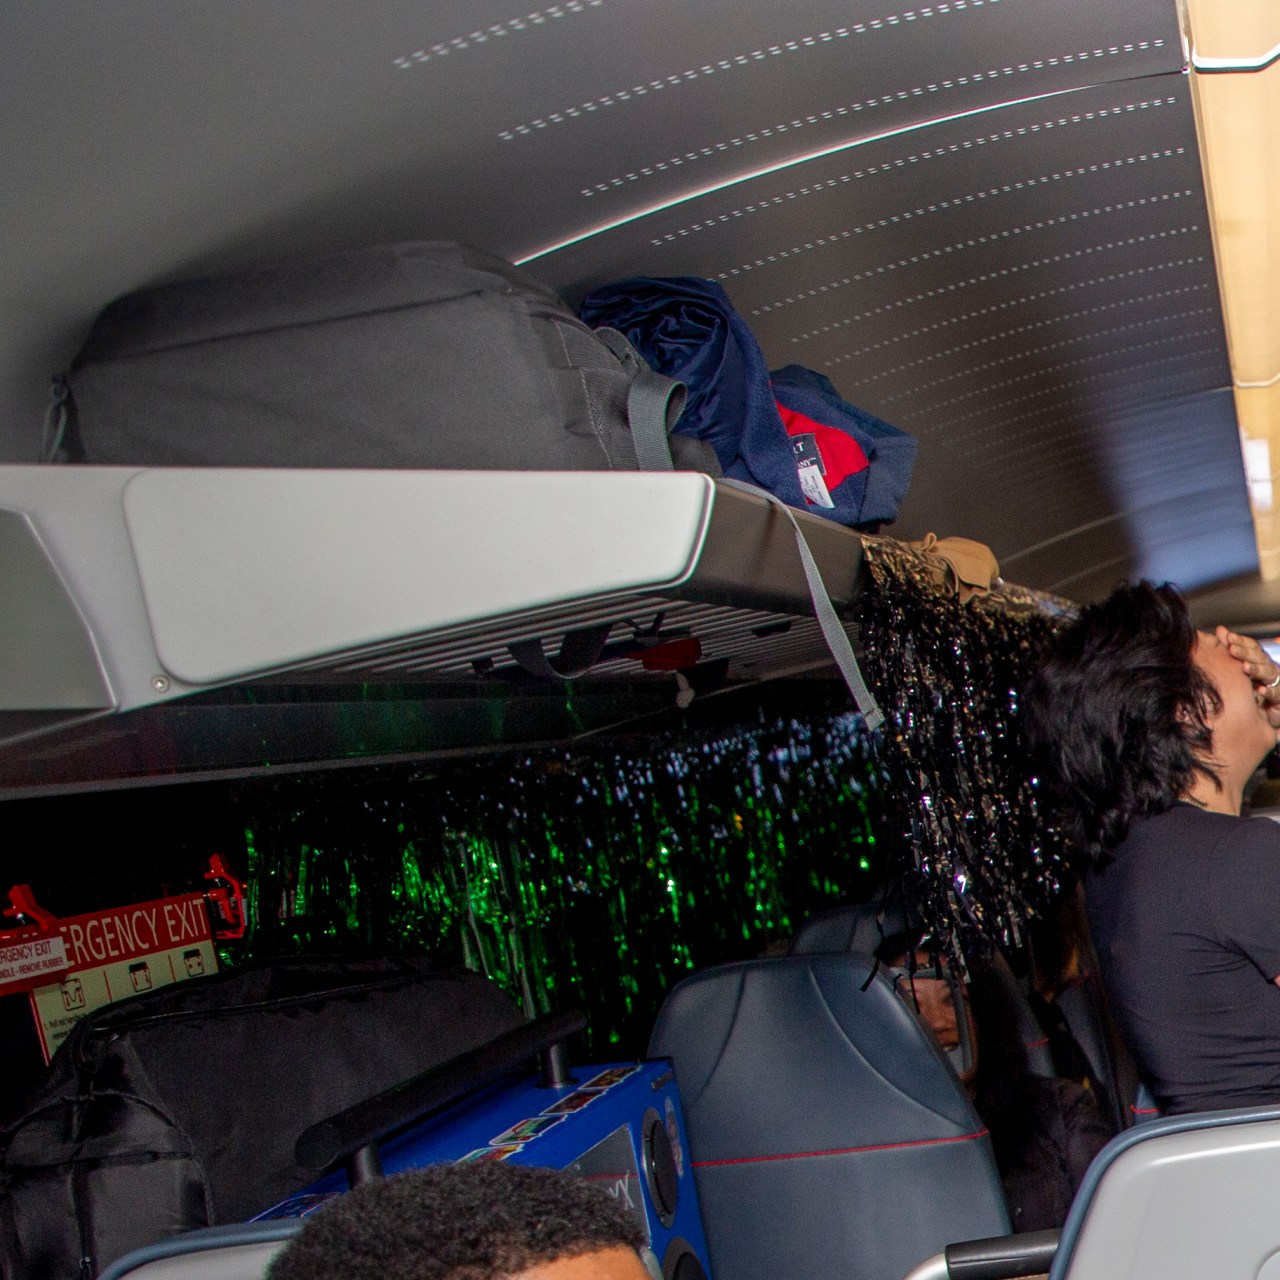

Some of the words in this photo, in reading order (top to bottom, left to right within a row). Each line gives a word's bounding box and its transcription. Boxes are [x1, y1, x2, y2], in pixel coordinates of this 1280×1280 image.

[164, 899, 208, 942] EXIT
[35, 941, 52, 957] EXIT
[19, 961, 42, 974] REMOVE
